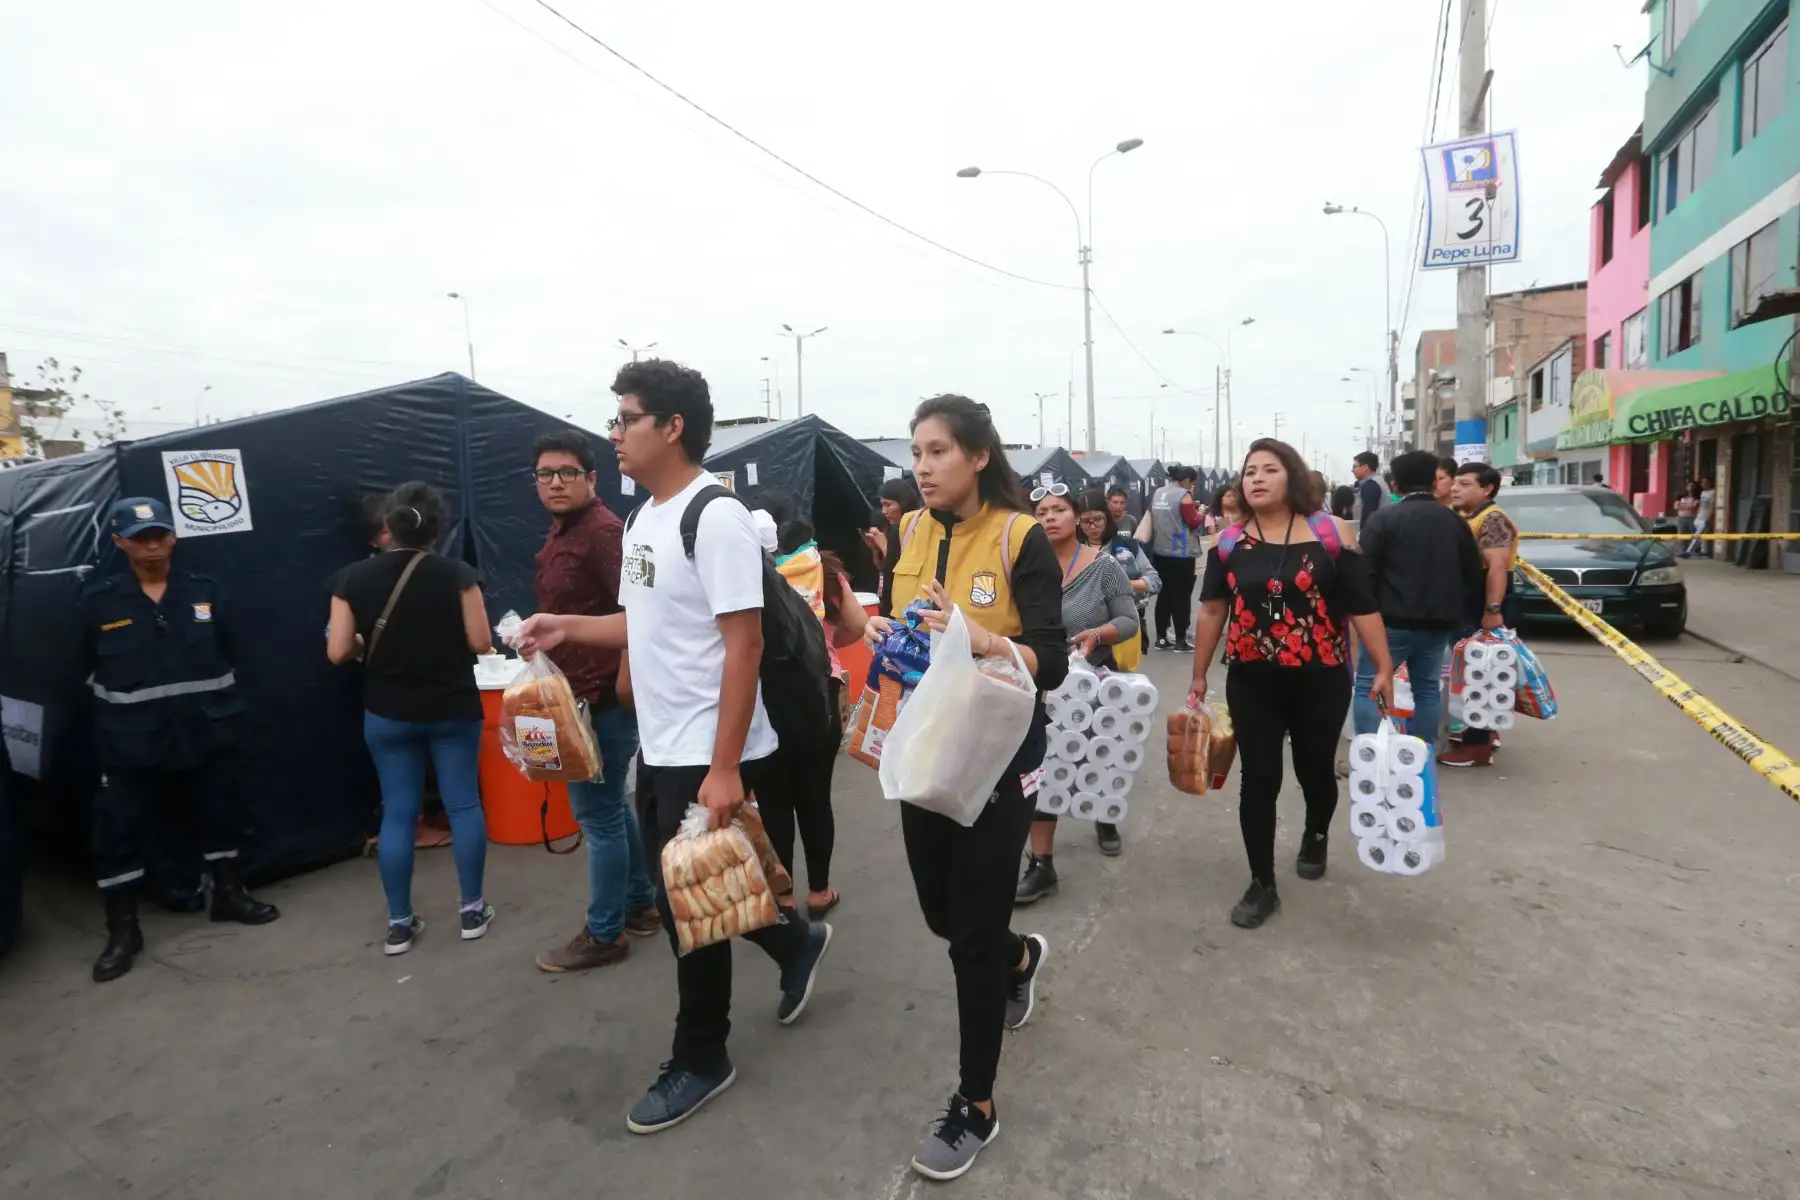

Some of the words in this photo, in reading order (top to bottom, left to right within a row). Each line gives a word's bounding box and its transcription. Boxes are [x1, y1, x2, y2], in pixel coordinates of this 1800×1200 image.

[1456, 197, 1485, 240] 3
[1432, 248, 1470, 260] Pepe
[1474, 244, 1511, 257] Luna
[1629, 405, 1697, 434] CHIFA
[1699, 392, 1789, 421] CALDO
[184, 518, 244, 532] MUNICIPALIDAD
